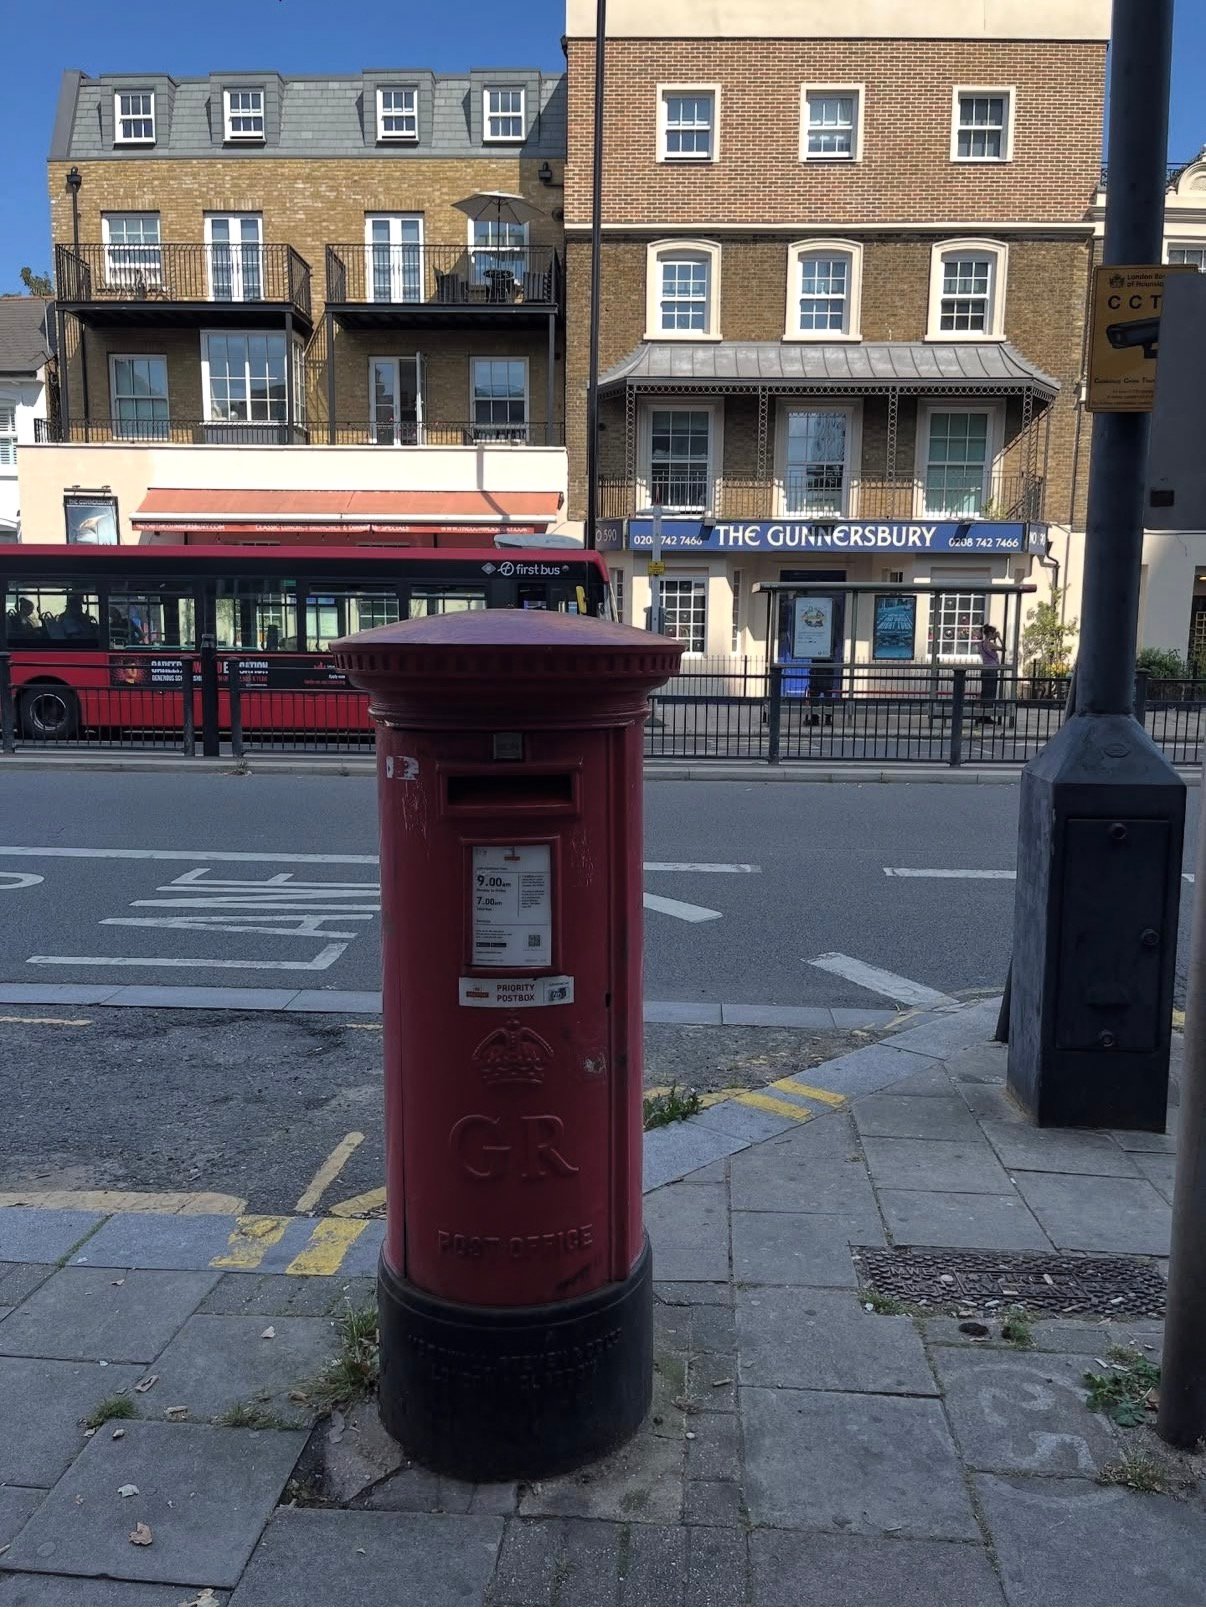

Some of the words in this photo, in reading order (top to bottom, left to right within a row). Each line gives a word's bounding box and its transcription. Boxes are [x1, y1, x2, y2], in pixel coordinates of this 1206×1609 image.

[1127, 273, 1153, 281] London
[1136, 280, 1164, 288] Hounslo
[1108, 295, 1162, 310] CCT
[603, 528, 617, 542] 590
[634, 535, 654, 545] 020
[661, 535, 678, 545] 742
[680, 535, 703, 546] 7466
[715, 525, 761, 546] THE
[767, 525, 936, 547] GUNNERSBURY
[948, 537, 973, 547] 0208
[976, 538, 993, 548] 742
[995, 538, 1019, 548] 7466
[516, 563, 539, 575] first
[540, 563, 560, 575] bus
[477, 874, 511, 887] 9.00am
[497, 984, 536, 992] PRIORITY
[497, 994, 535, 1002] POSTBOX
[449, 1114, 580, 1178] GR
[438, 1229, 502, 1256] POST
[509, 1224, 594, 1257] OFFICE
